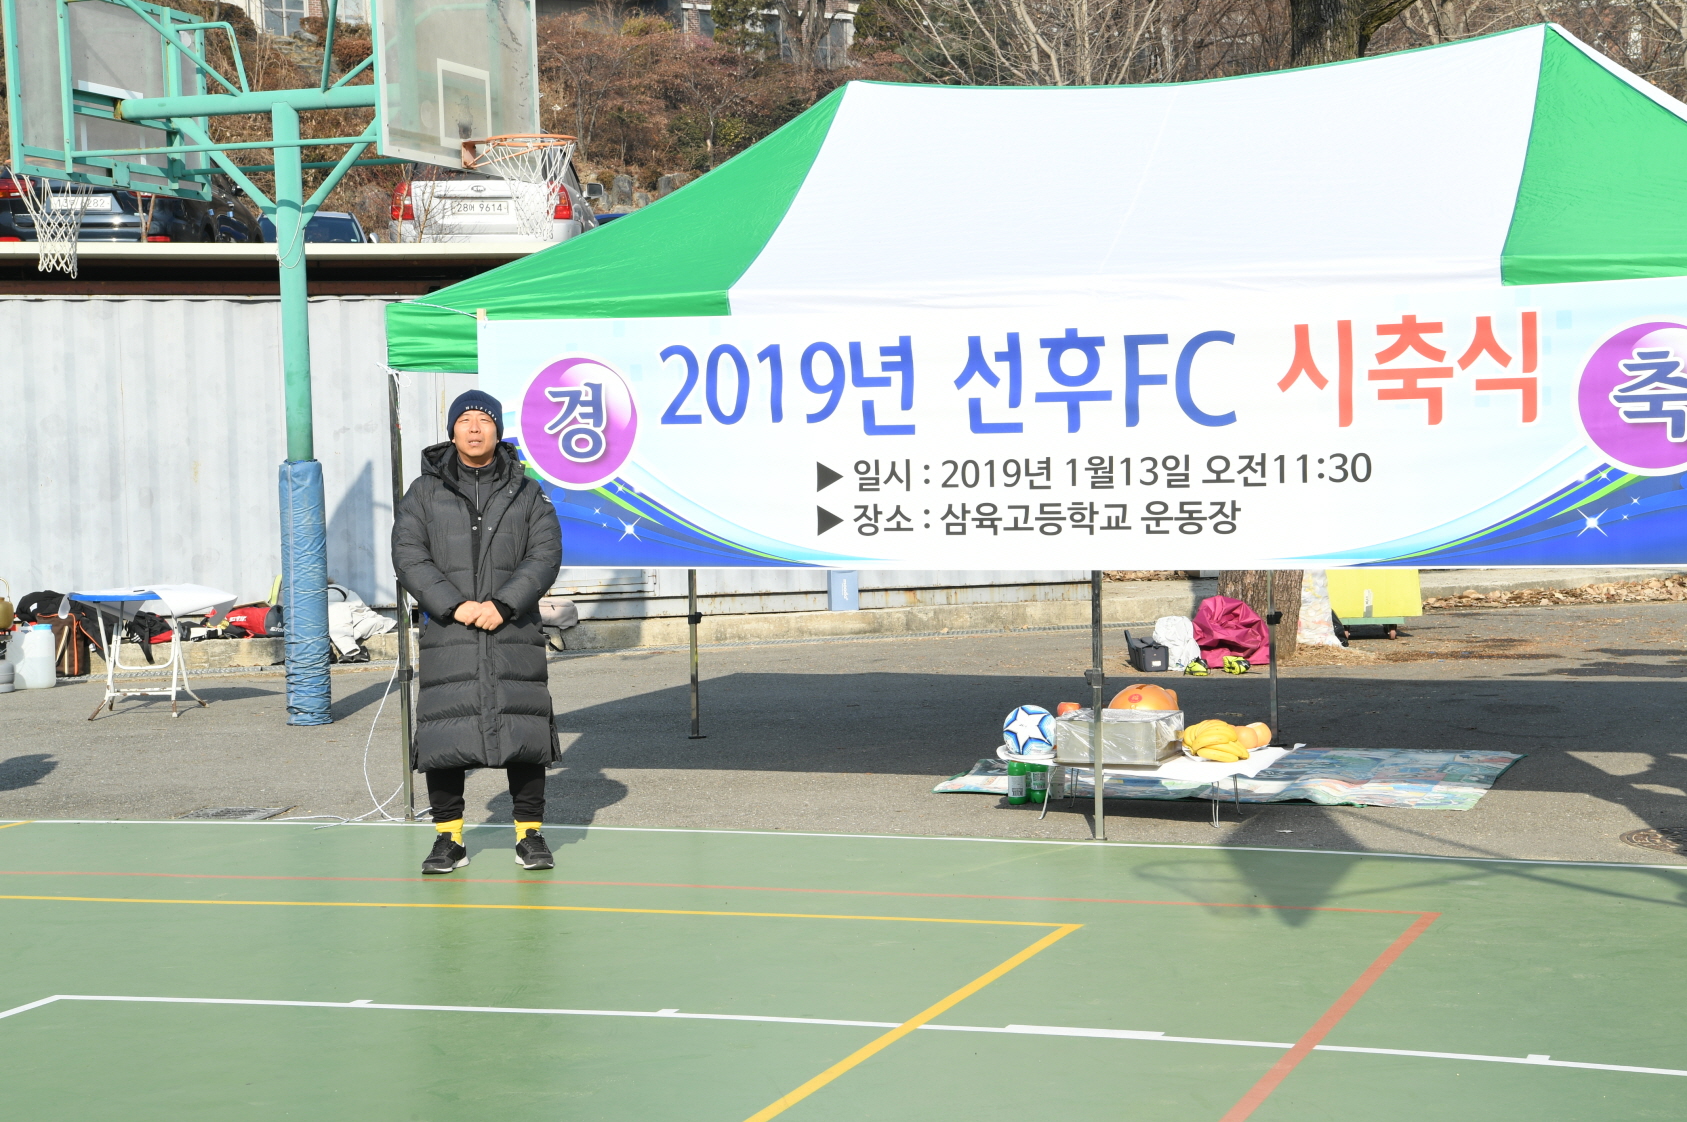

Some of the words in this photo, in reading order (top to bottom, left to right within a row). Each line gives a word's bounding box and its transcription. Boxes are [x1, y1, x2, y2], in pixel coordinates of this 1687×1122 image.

[479, 203, 502, 213] 9614
[661, 336, 914, 435] 2019년
[955, 329, 1236, 434] 선후FC
[1278, 312, 1538, 428] 시축식
[1611, 349, 1687, 440] 축
[545, 381, 606, 461] 경
[854, 459, 911, 491] 일시
[942, 457, 1051, 489] 2019년
[1067, 455, 1189, 489] 1월13일
[1202, 453, 1372, 486] 오전11:30
[854, 504, 914, 536] 장소
[941, 502, 1131, 536] 삼육고등학교
[1141, 500, 1242, 534] 운동장
